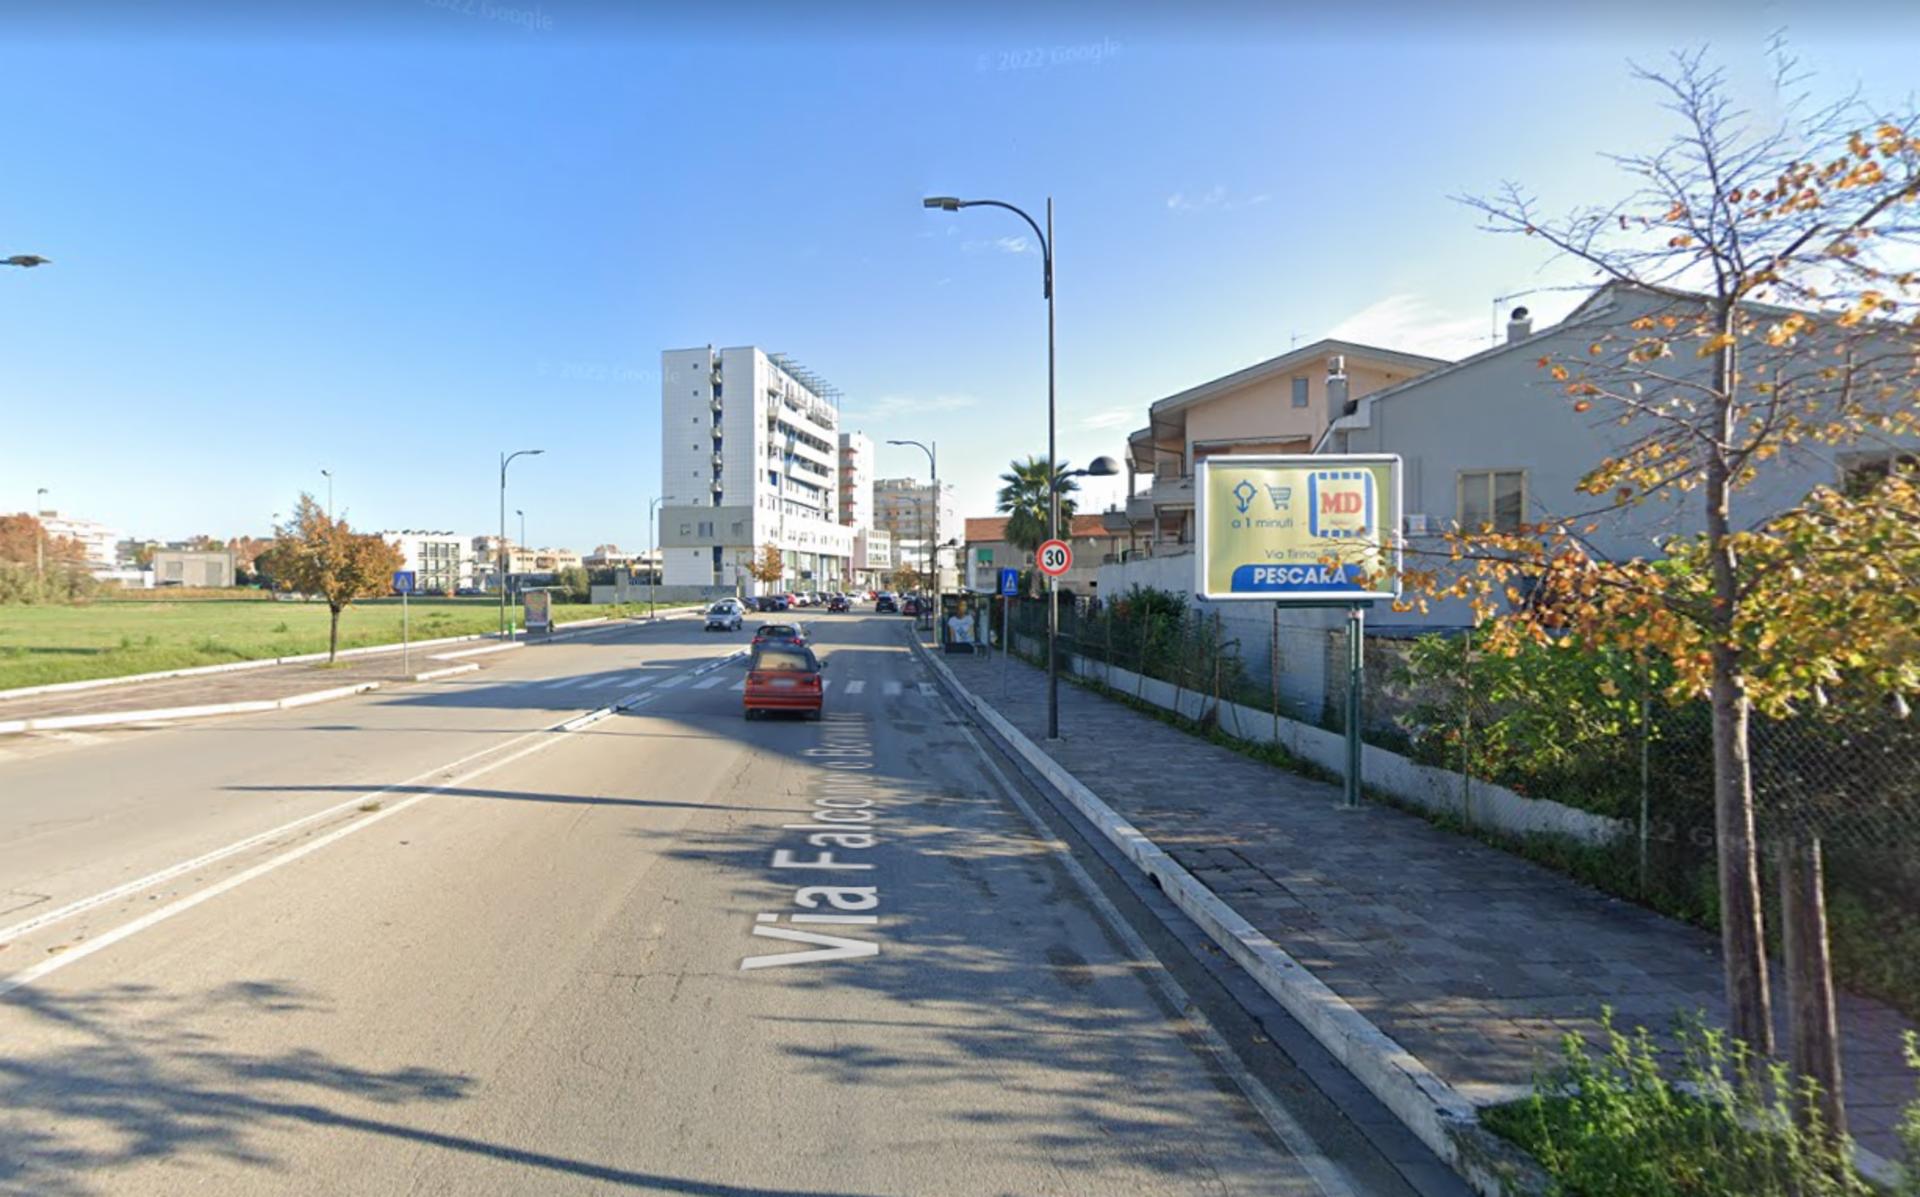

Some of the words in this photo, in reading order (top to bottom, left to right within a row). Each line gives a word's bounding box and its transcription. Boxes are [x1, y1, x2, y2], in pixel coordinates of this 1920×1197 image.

[1320, 492, 1362, 514] MD
[1231, 518, 1240, 528] a
[1255, 516, 1294, 528] minuti
[1045, 549, 1065, 567] 30
[1253, 566, 1348, 585] PESCARA
